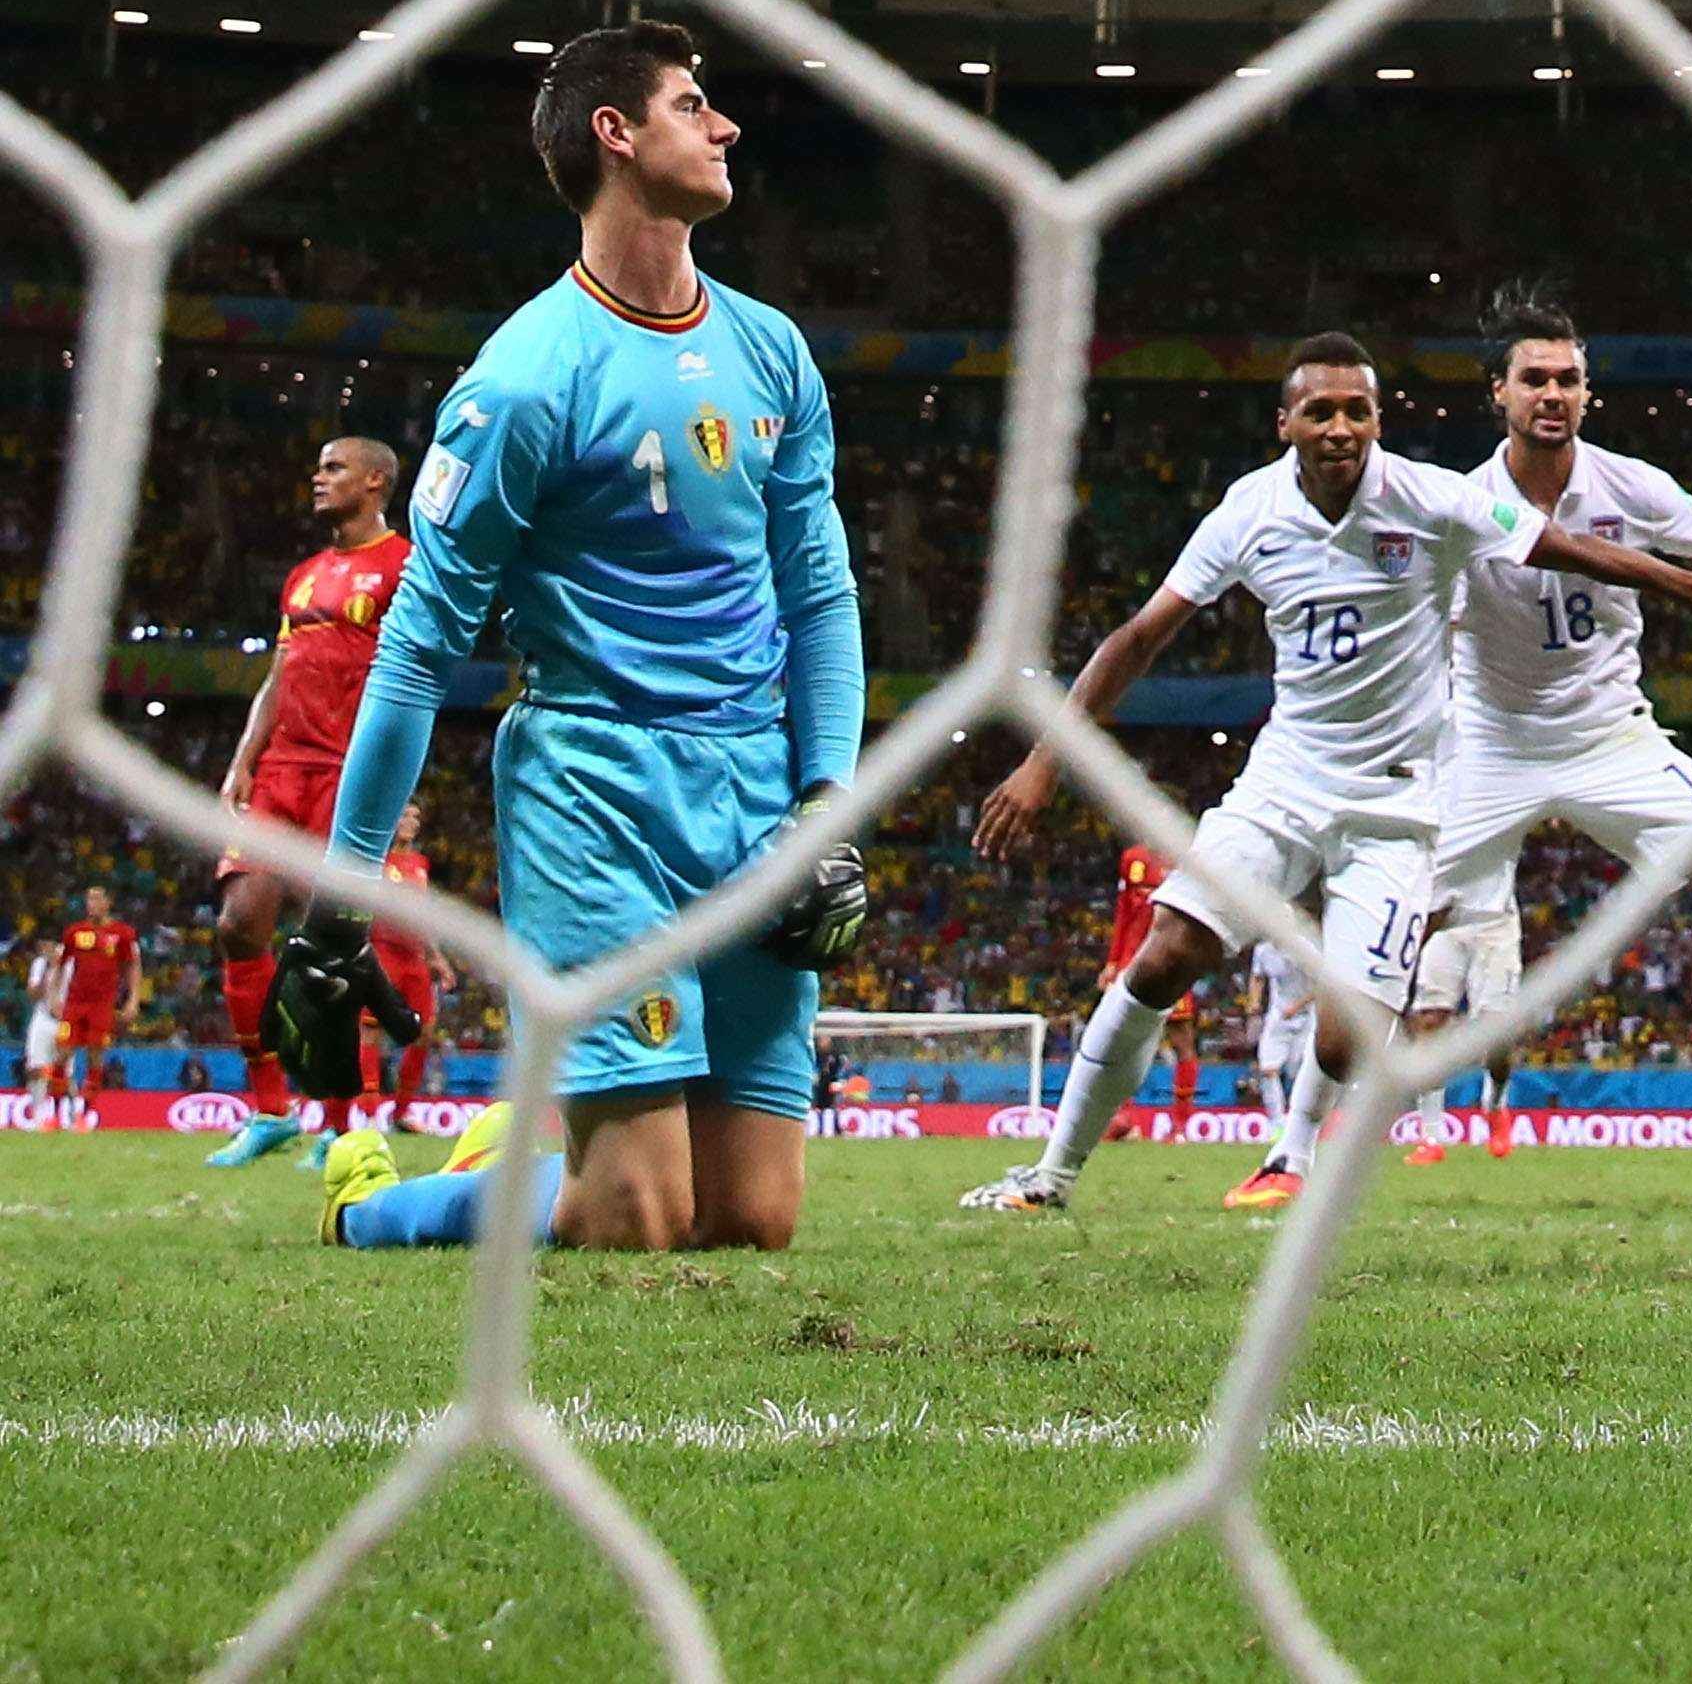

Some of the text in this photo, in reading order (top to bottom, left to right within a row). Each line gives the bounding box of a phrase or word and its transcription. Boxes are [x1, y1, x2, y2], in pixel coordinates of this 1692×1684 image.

[631, 429, 669, 516] 1
[1298, 600, 1364, 664] 16
[1539, 592, 1597, 652] 18
